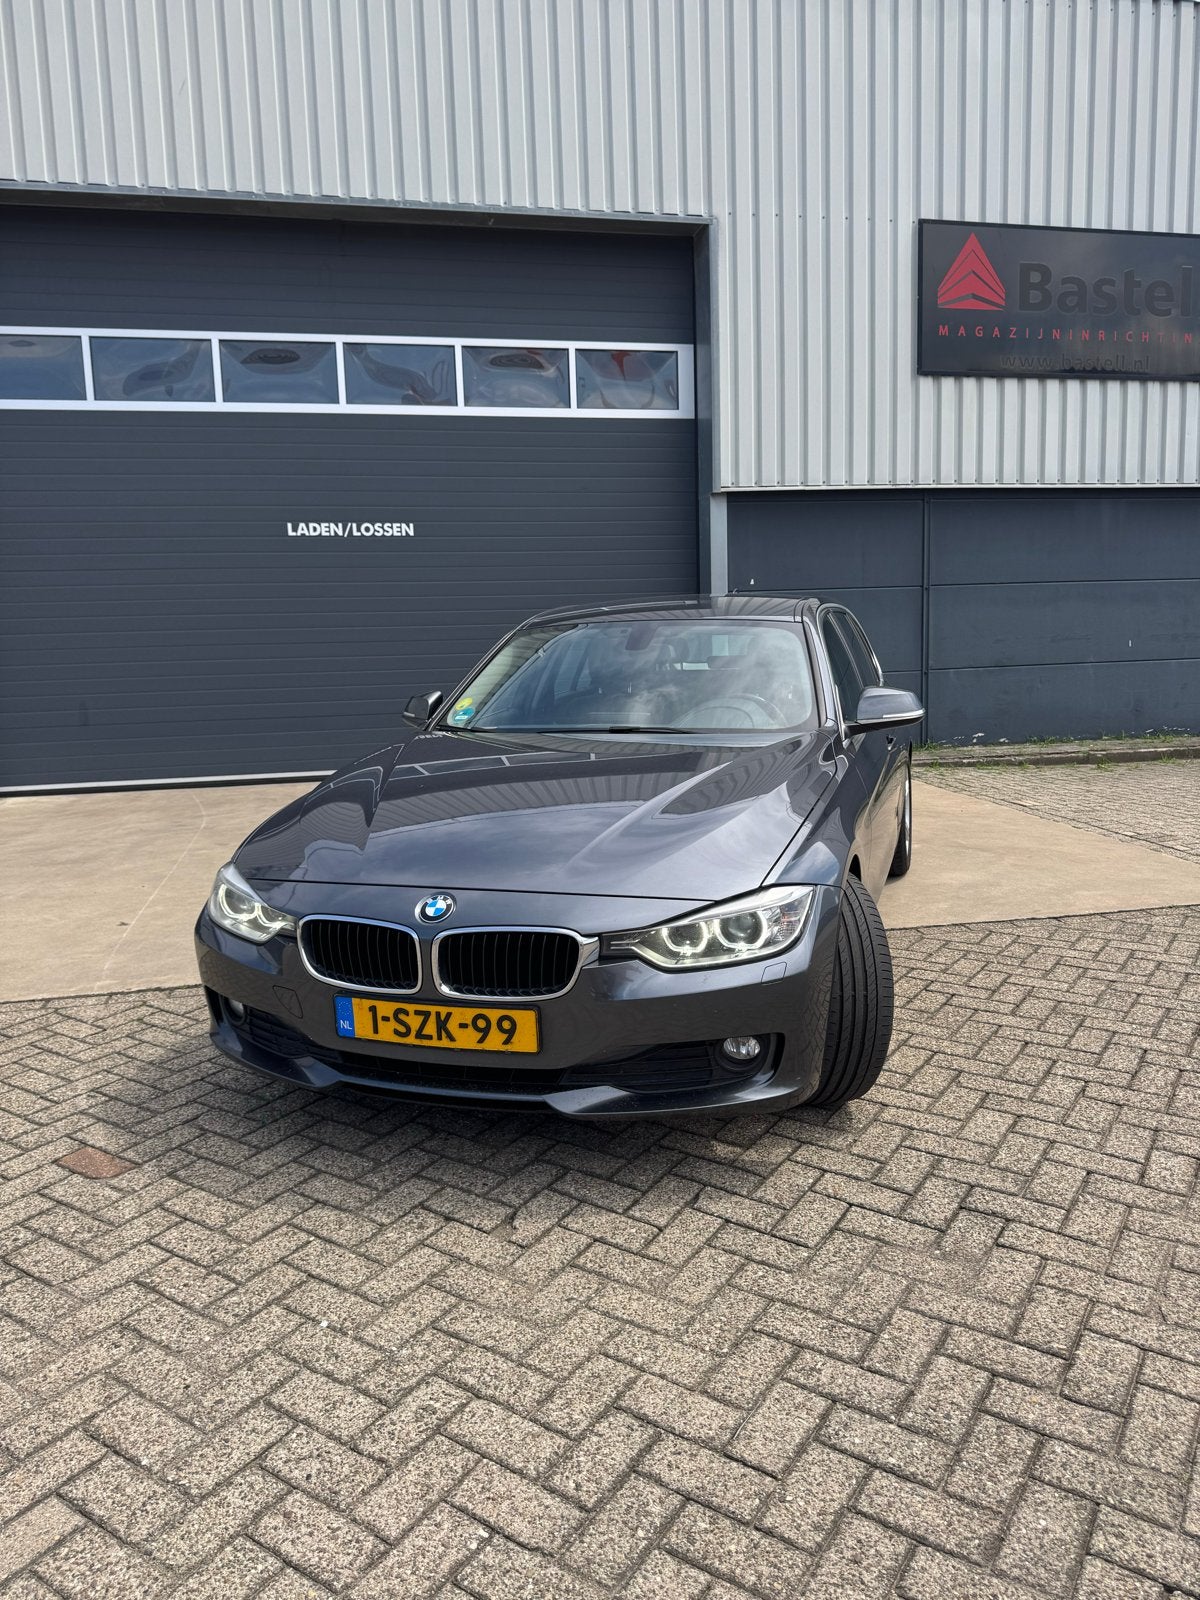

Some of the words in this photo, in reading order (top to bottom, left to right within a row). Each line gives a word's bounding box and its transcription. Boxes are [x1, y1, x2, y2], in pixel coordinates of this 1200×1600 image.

[286, 522, 415, 537] LADEN/LOSSEN
[340, 1019, 353, 1030] NL
[368, 1004, 517, 1046] 1-SZK-99
